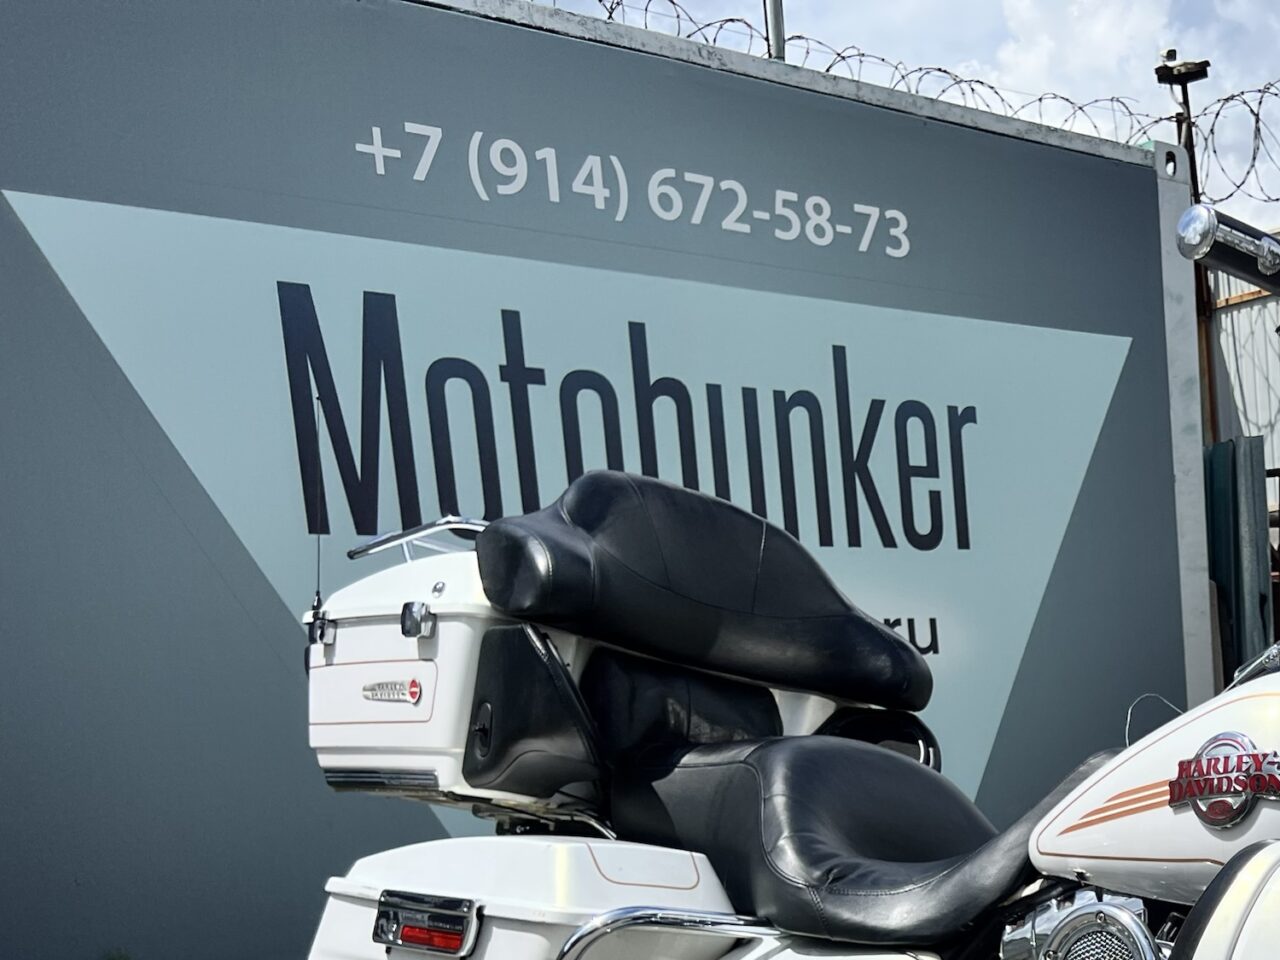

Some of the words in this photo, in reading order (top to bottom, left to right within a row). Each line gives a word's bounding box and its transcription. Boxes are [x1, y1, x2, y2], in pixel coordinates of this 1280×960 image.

[355, 122, 443, 181] +7
[468, 130, 628, 222] (914)
[647, 168, 911, 258] 672-58-73
[276, 280, 978, 552] Motobunker
